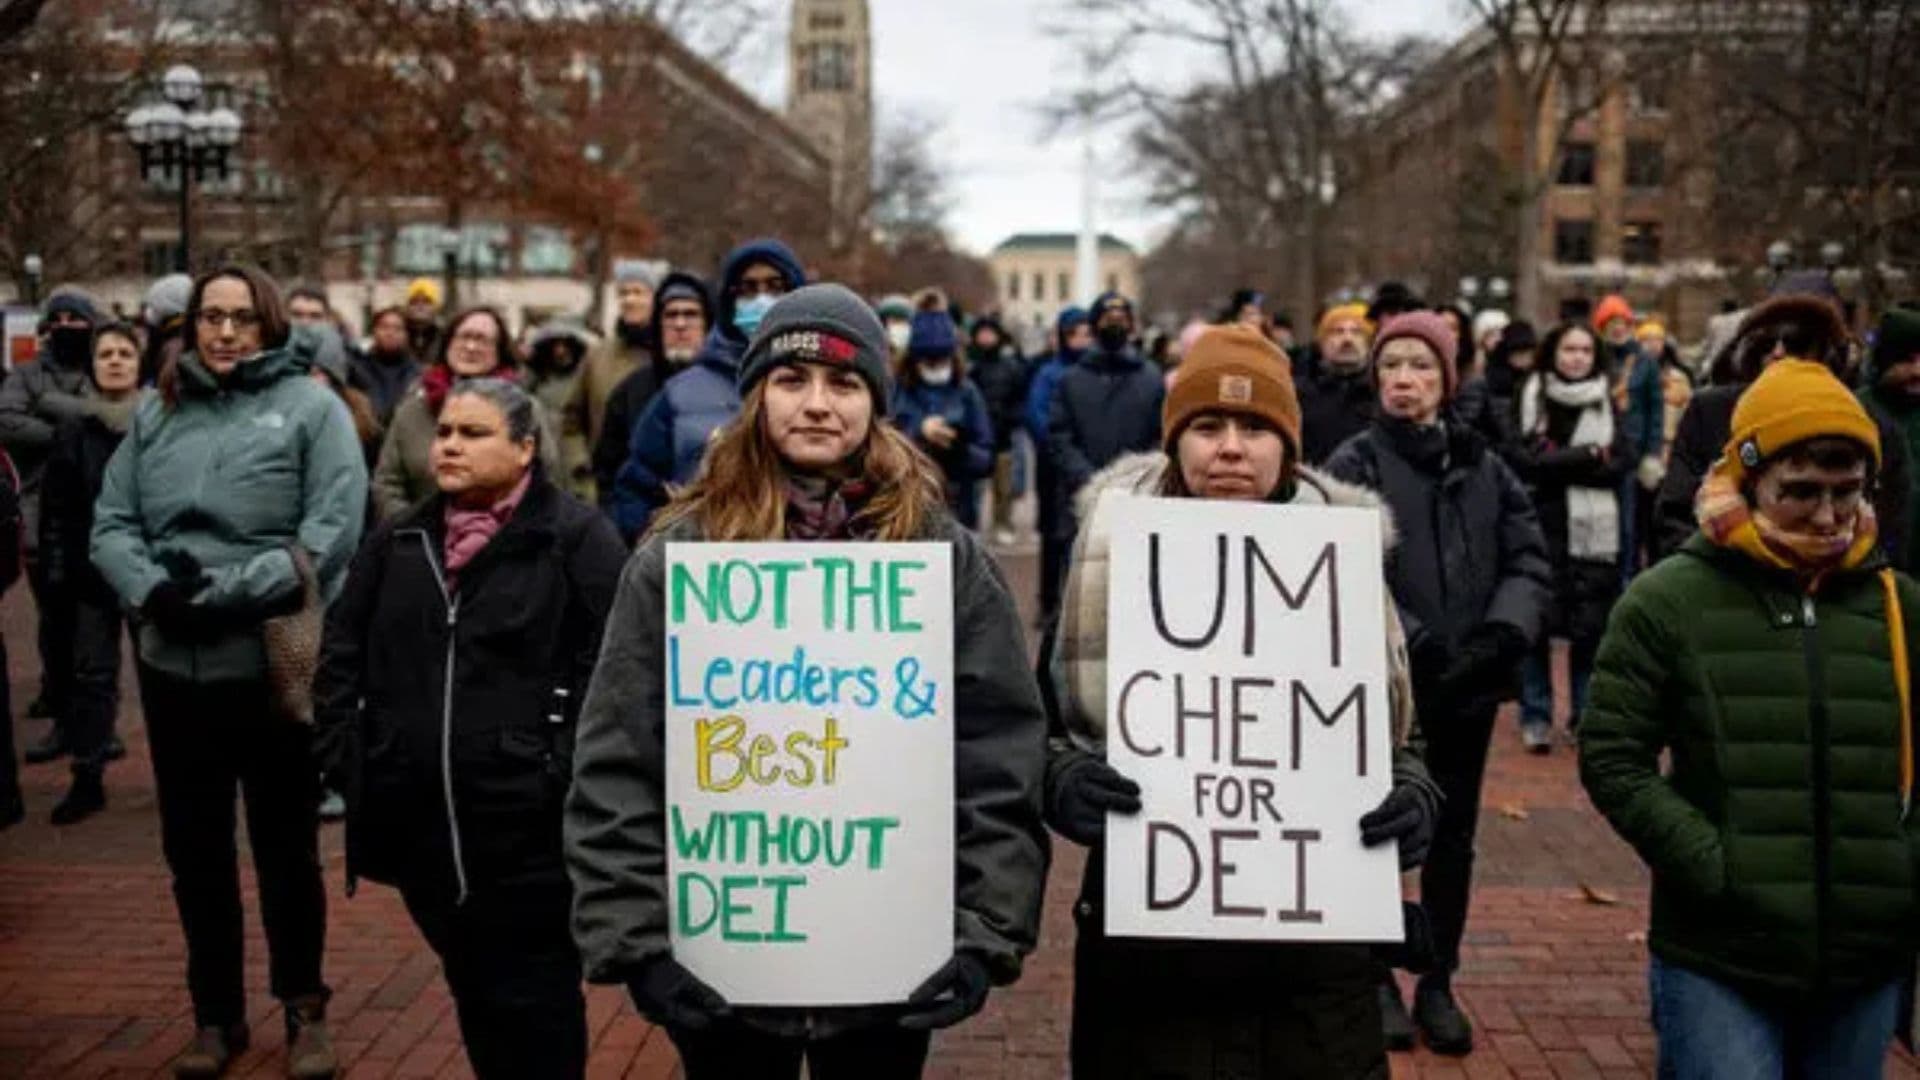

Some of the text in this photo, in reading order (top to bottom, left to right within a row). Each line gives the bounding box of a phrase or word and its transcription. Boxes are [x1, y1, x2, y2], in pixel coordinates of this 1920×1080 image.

[671, 558, 927, 632] NOT THE
[1149, 533, 1341, 667] UM
[669, 636, 936, 718] Leaders &
[695, 715, 848, 792] Best
[1118, 670, 1367, 776] CHEM
[672, 805, 899, 869] WITHOUT
[1196, 774, 1283, 823] FOR
[678, 872, 807, 942] DEI
[1146, 821, 1323, 923] DEI
